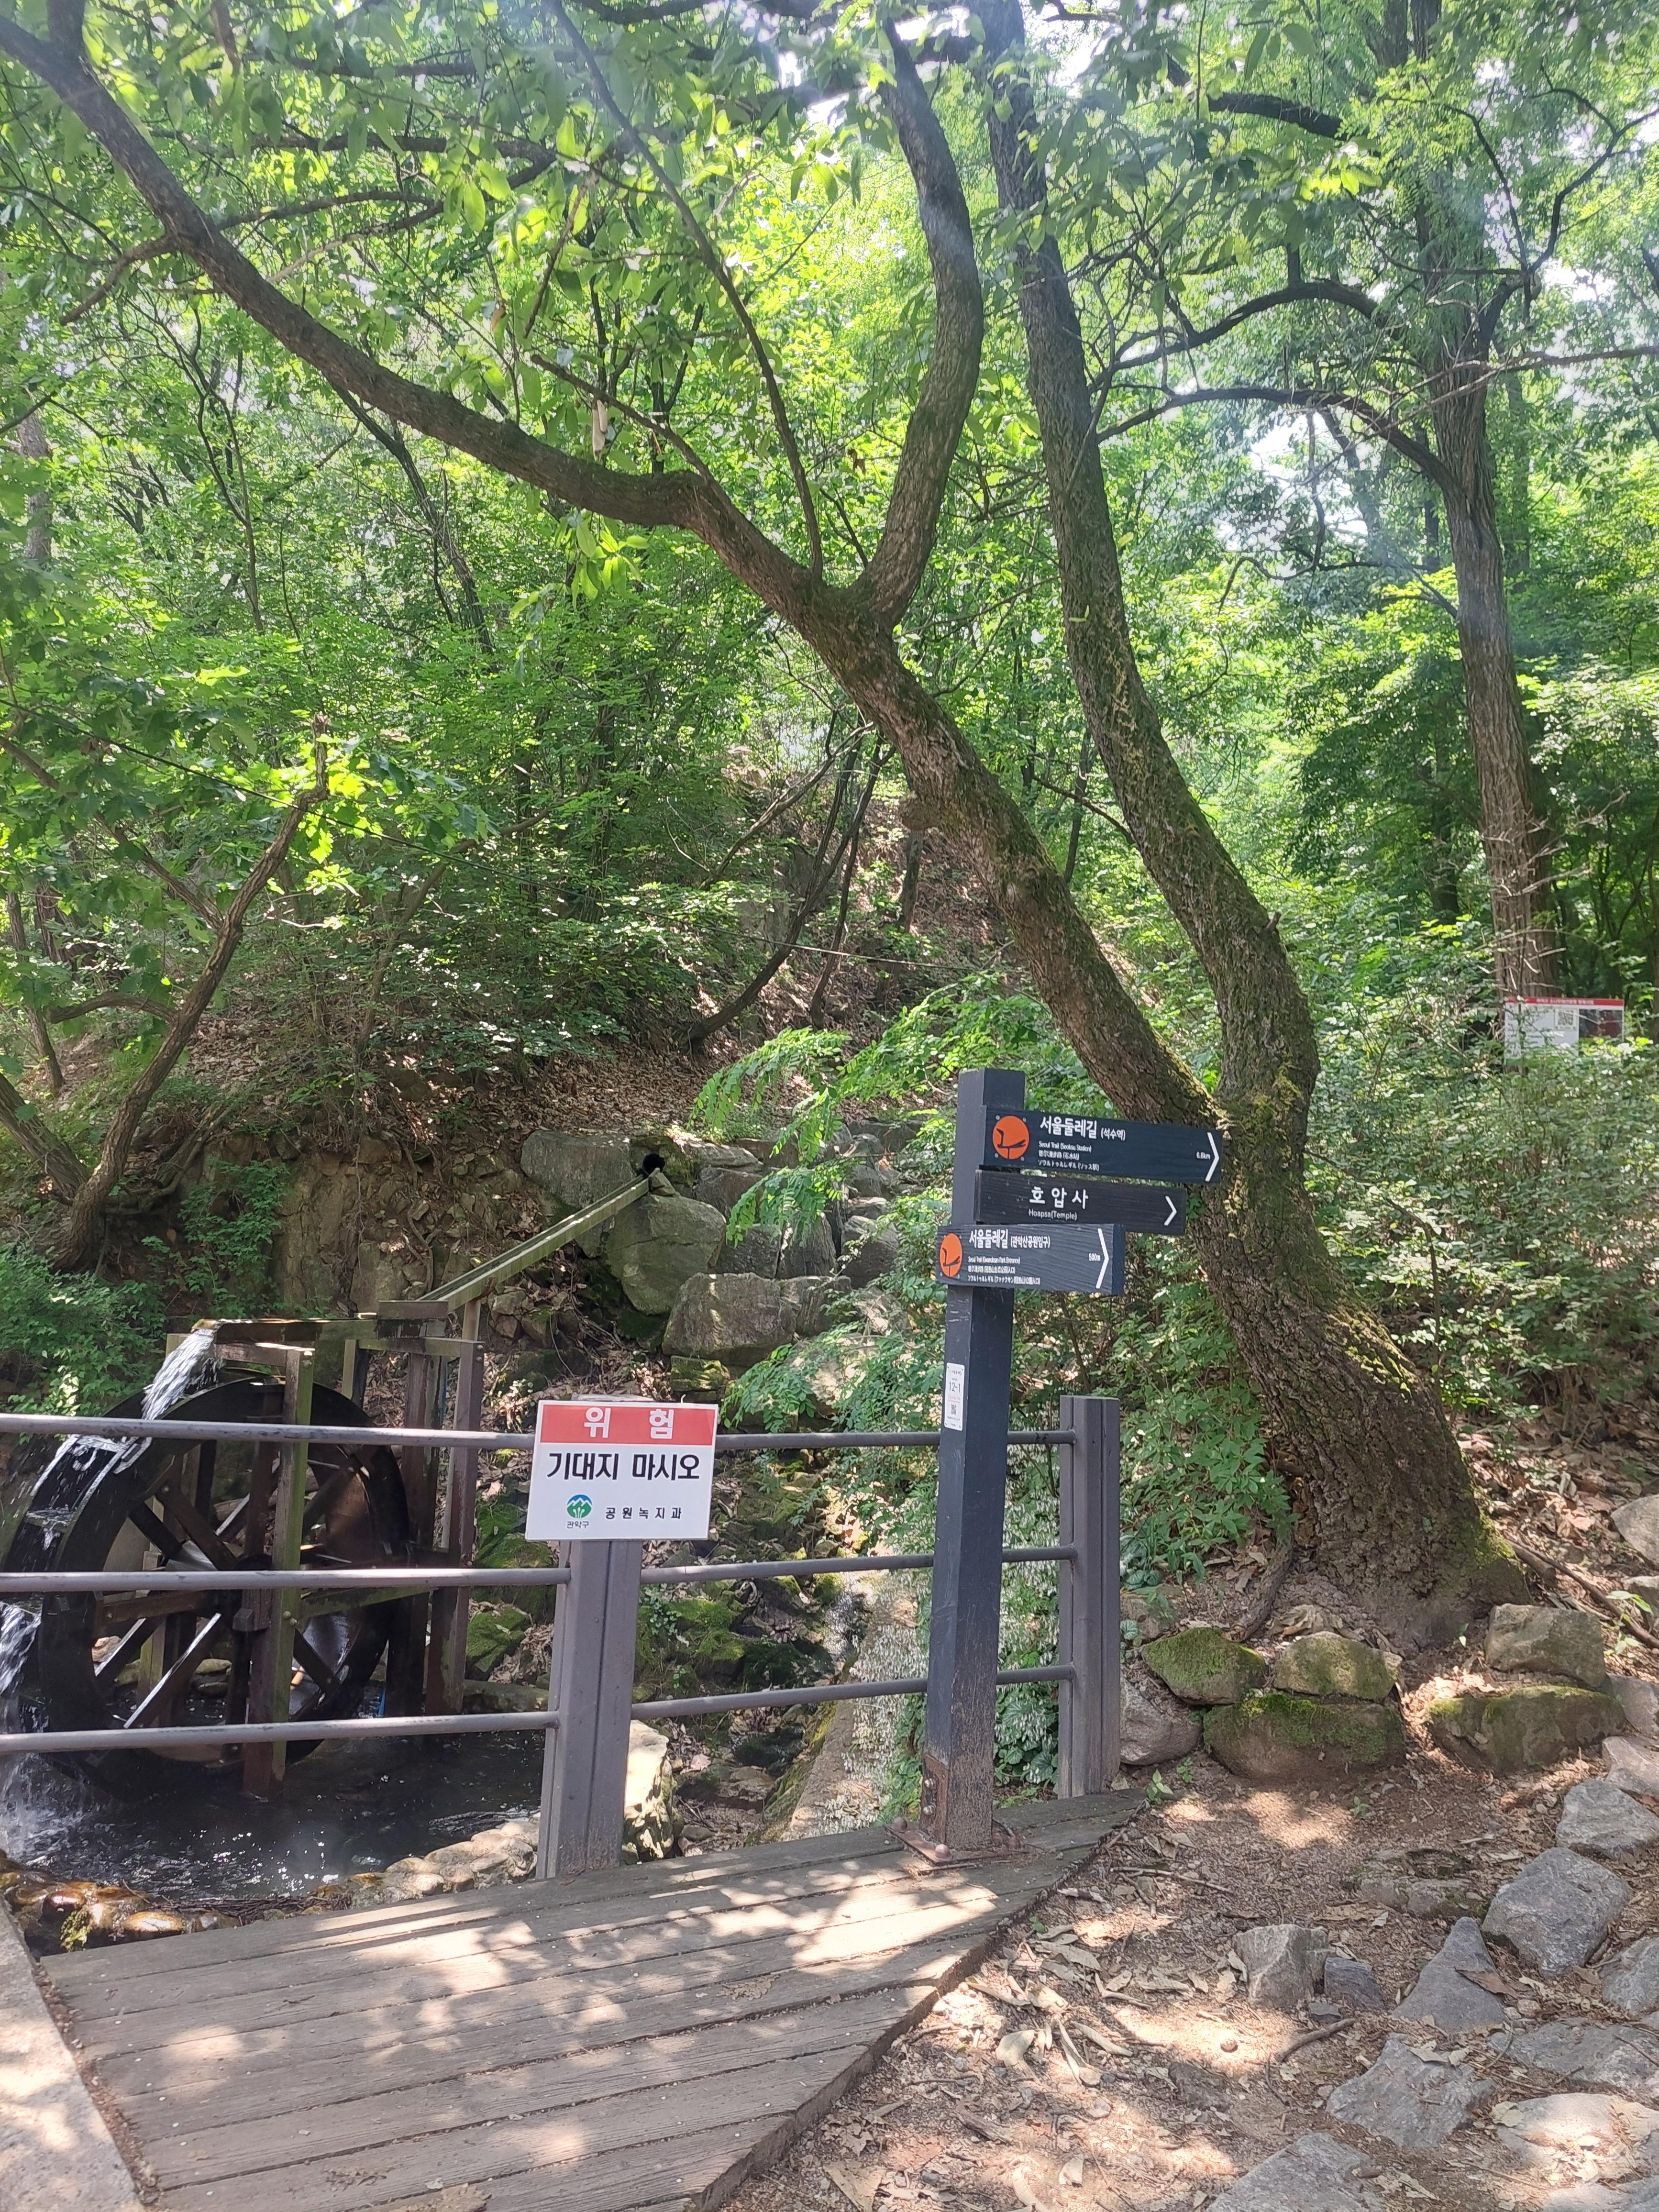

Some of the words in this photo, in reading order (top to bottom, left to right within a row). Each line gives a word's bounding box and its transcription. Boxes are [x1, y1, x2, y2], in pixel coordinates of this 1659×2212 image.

[1040, 1115, 1097, 1139] 서울둘레길
[1101, 1127, 1126, 1141] (석수역)
[1039, 1140, 1051, 1149] Seoul
[1060, 1142, 1076, 1151] (Seoksu
[1076, 1144, 1092, 1153] Station)
[969, 1228, 1008, 1249] 서울둘레길
[1010, 1235, 1051, 1249] (관악산공원입구)
[1089, 1253, 1101, 1261] 500m
[949, 1382, 961, 1393] 12-1
[547, 1452, 619, 1481] 기대지
[632, 1453, 700, 1481] 마시오
[566, 1521, 589, 1529] 관악구
